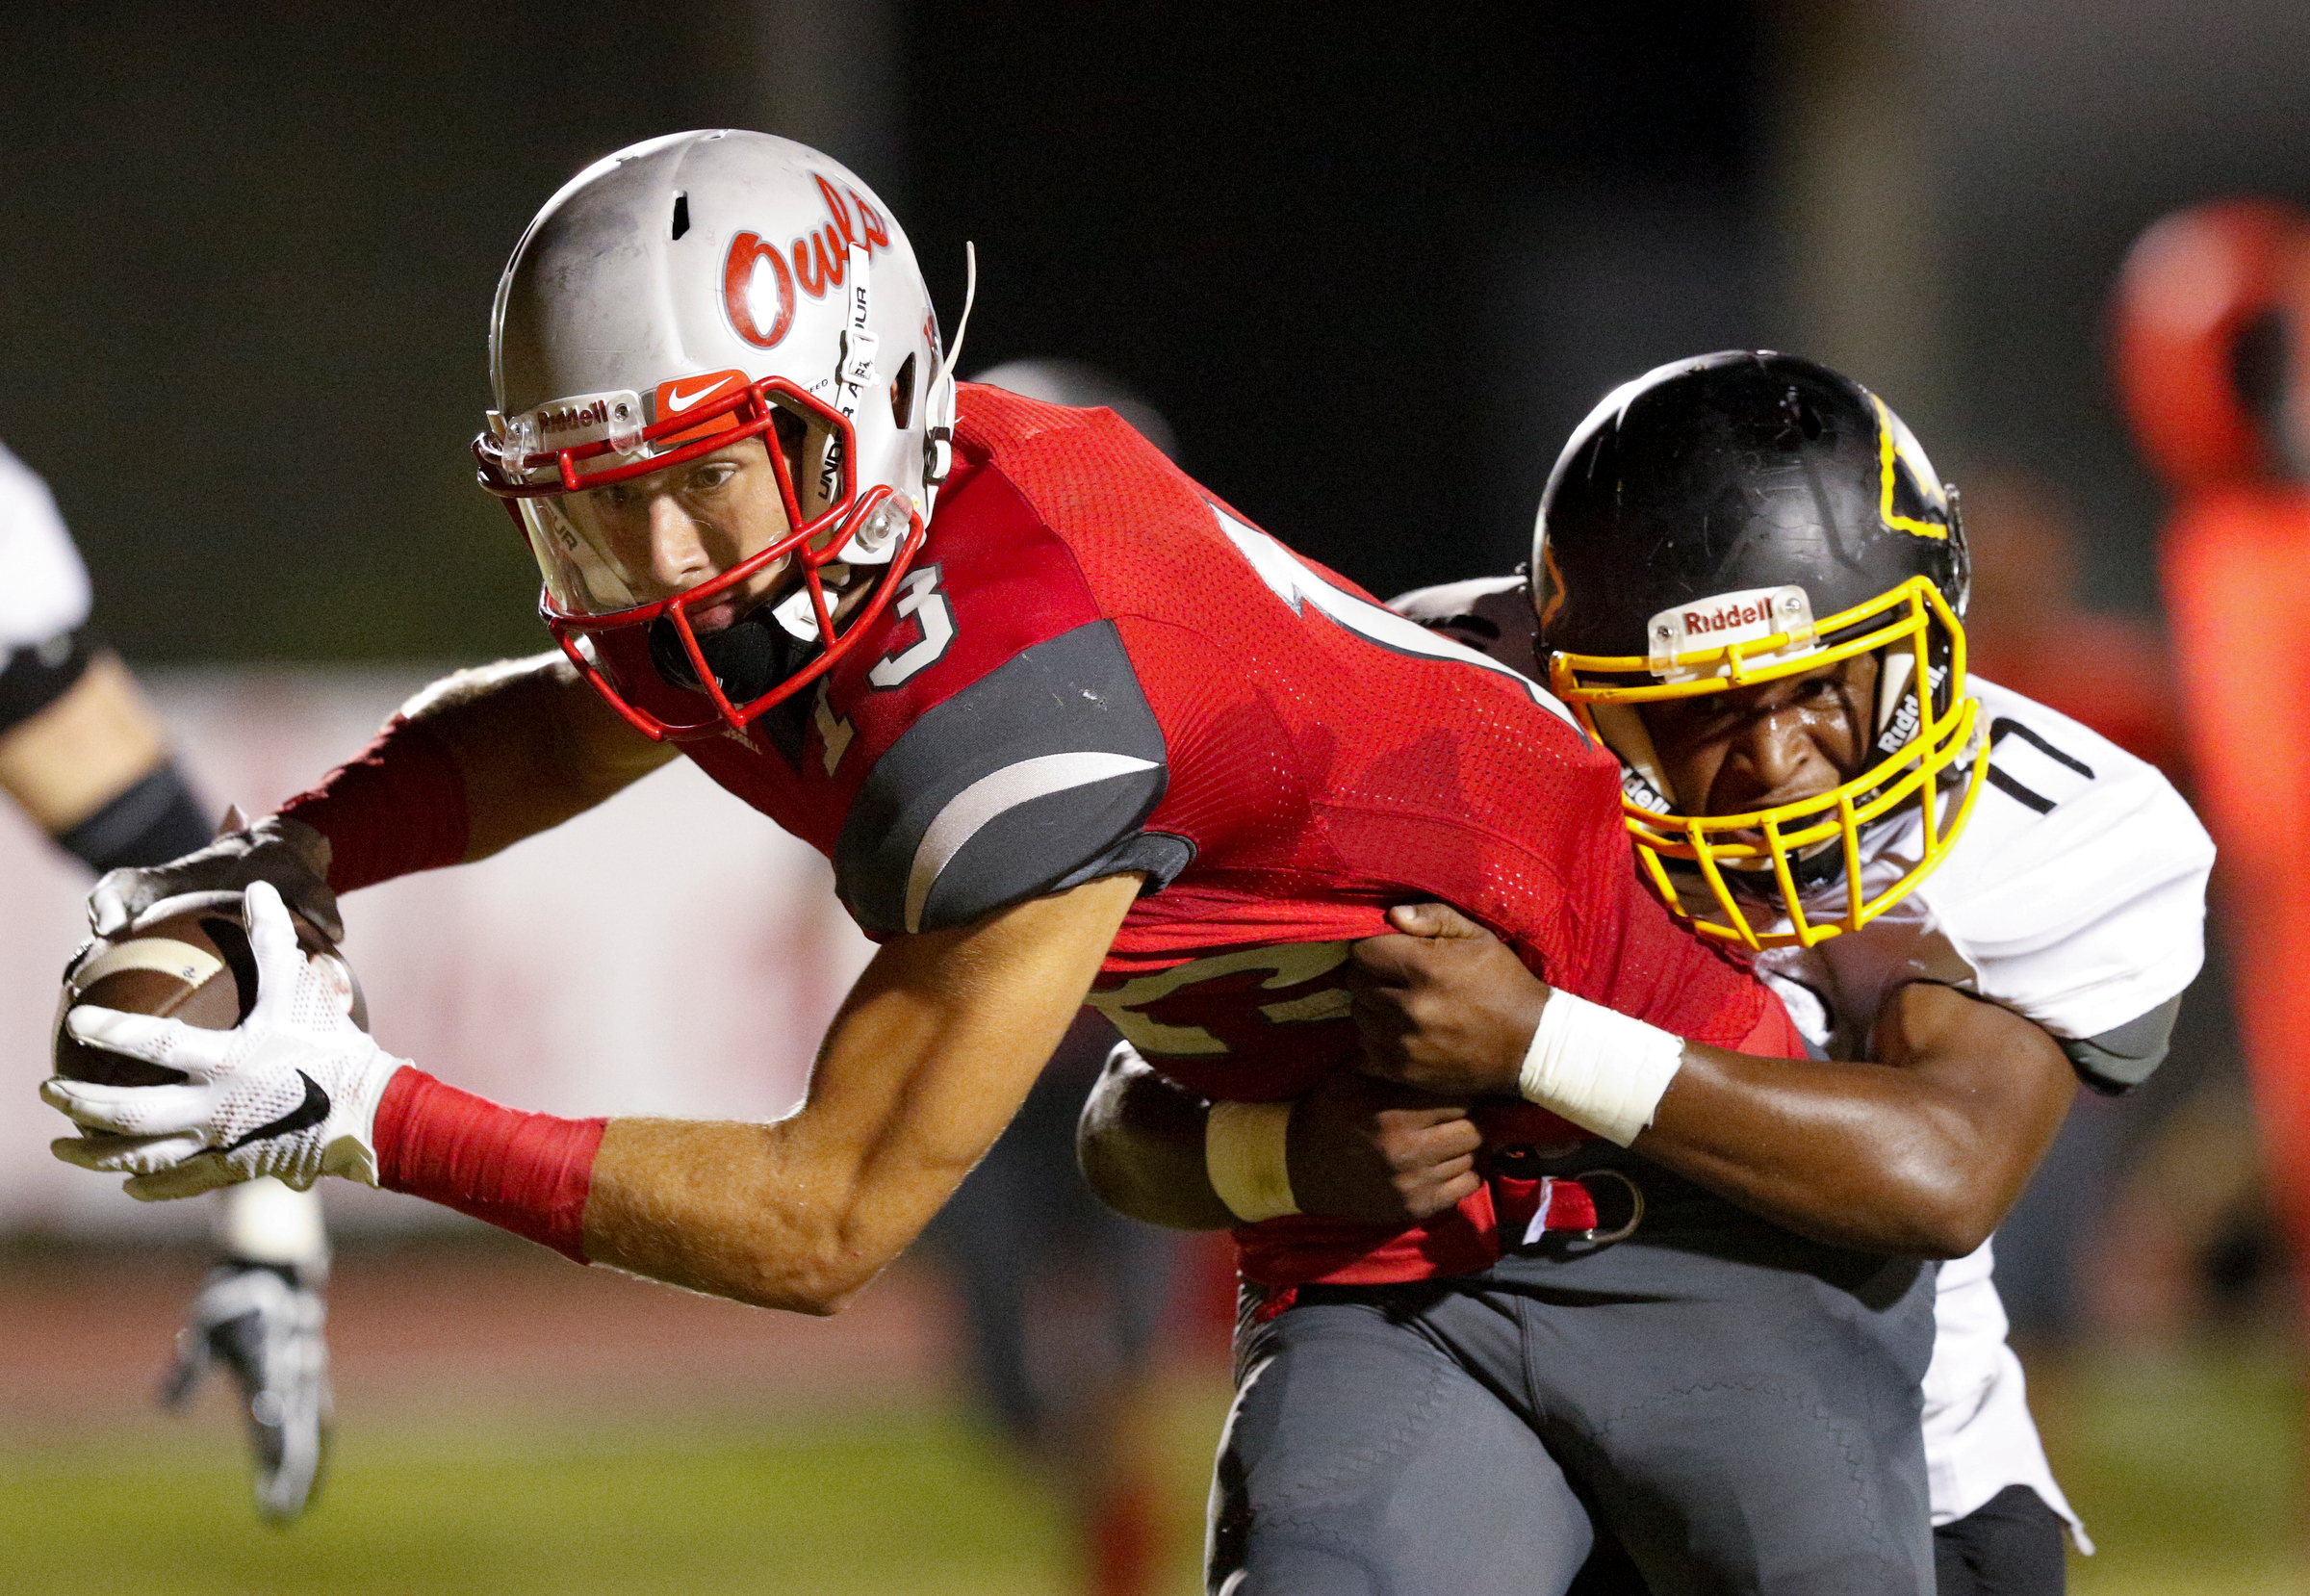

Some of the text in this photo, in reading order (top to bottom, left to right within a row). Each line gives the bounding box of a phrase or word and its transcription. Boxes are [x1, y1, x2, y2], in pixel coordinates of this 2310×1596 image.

[722, 170, 893, 350] Owls
[807, 378, 829, 393] EED
[1684, 597, 1773, 635] Riddell
